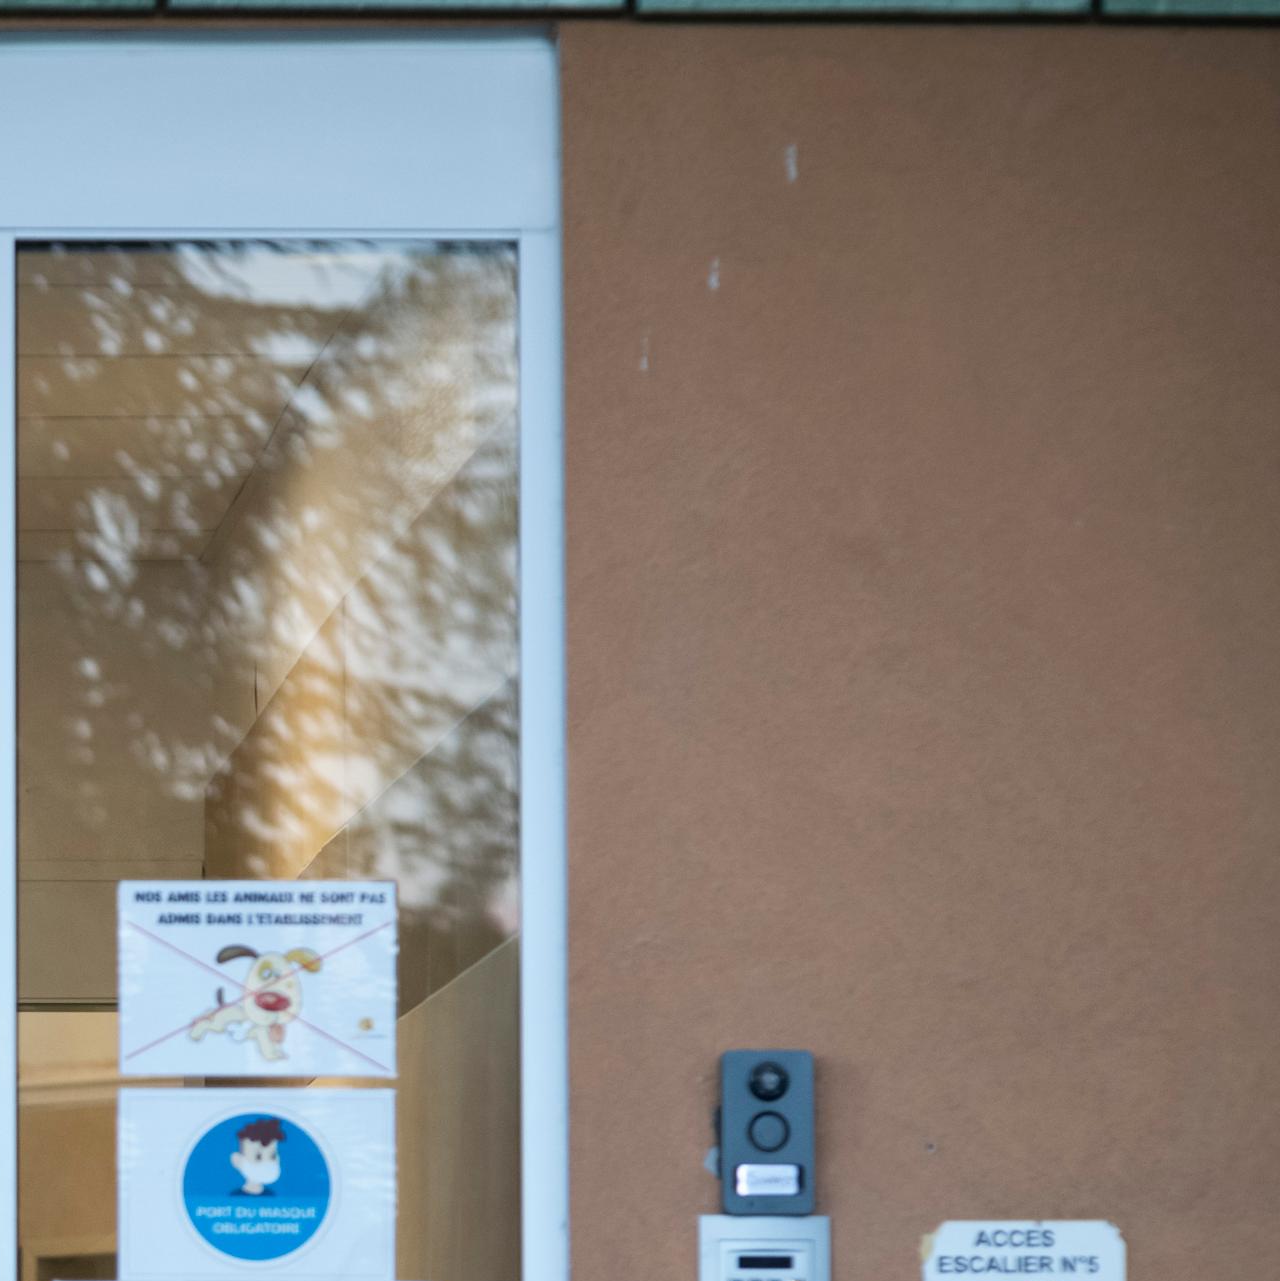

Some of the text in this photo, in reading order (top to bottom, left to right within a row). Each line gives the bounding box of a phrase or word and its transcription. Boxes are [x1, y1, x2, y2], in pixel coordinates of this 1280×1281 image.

[135, 892, 162, 902] NOS
[321, 892, 354, 902] SONT
[360, 892, 385, 903] PAS
[207, 913, 241, 925] DANS
[197, 1206, 315, 1219] PORT DU MASQUE
[212, 1222, 300, 1234] OBLIGATOIRE
[976, 1230, 1054, 1248] ACCES
[938, 1256, 1100, 1273] ESCALIER N°5
